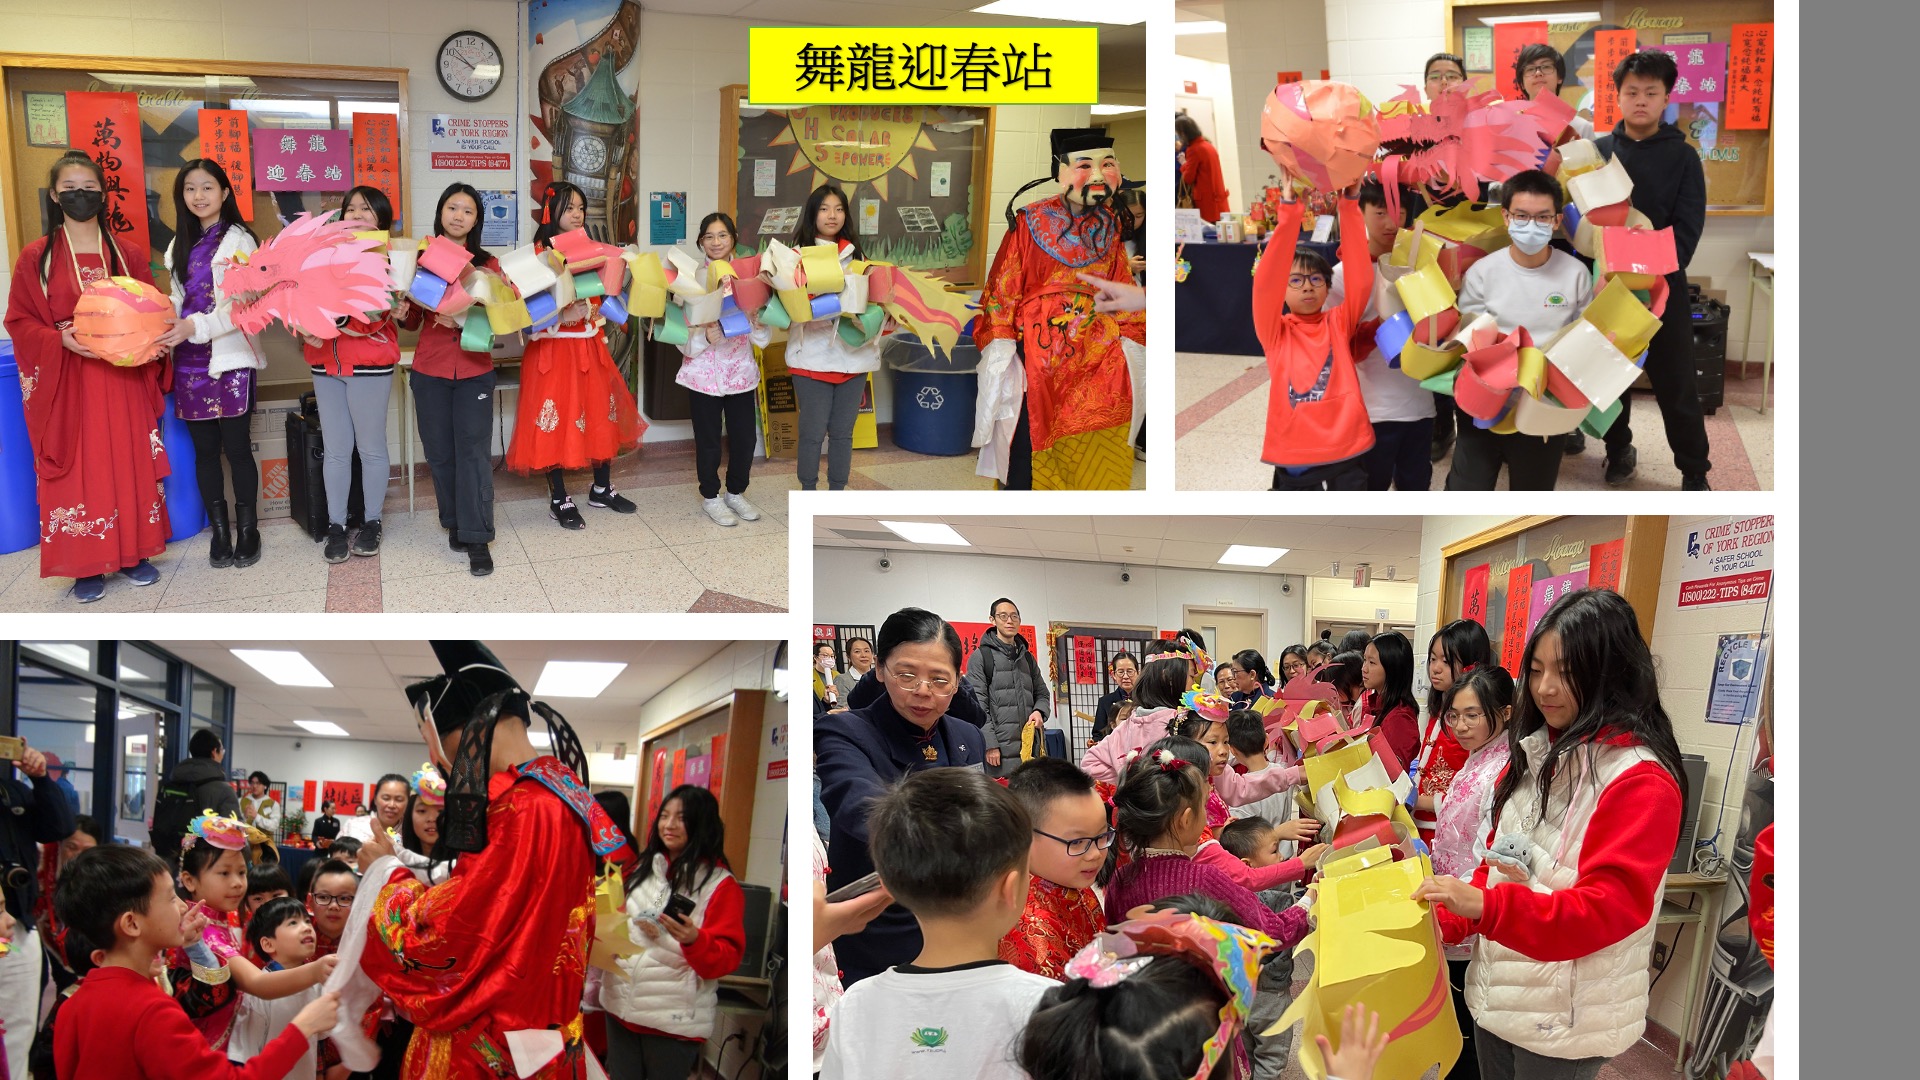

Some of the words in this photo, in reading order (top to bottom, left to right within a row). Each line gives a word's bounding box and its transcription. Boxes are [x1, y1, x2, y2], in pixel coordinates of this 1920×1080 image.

[448, 119, 470, 127] CRIME
[473, 119, 509, 128] STOPPERS
[448, 128, 458, 137] OF
[461, 129, 479, 137] YORK
[482, 129, 508, 138] REGION
[280, 134, 328, 154] 舞龍
[841, 152, 885, 167] POWER
[267, 163, 343, 183] 迎春站
[1704, 524, 1731, 541] CRIME
[1703, 543, 1714, 555] OF
[1716, 537, 1739, 552] YORK
[1741, 530, 1774, 548] REGION
[1715, 554, 1734, 563] SAFER
[1736, 550, 1763, 561] SCHOOL
[1721, 563, 1737, 571] YOUR
[1739, 560, 1755, 569] CALL
[1740, 582, 1766, 597] (8477)
[1719, 641, 1748, 673] RECYCLE
